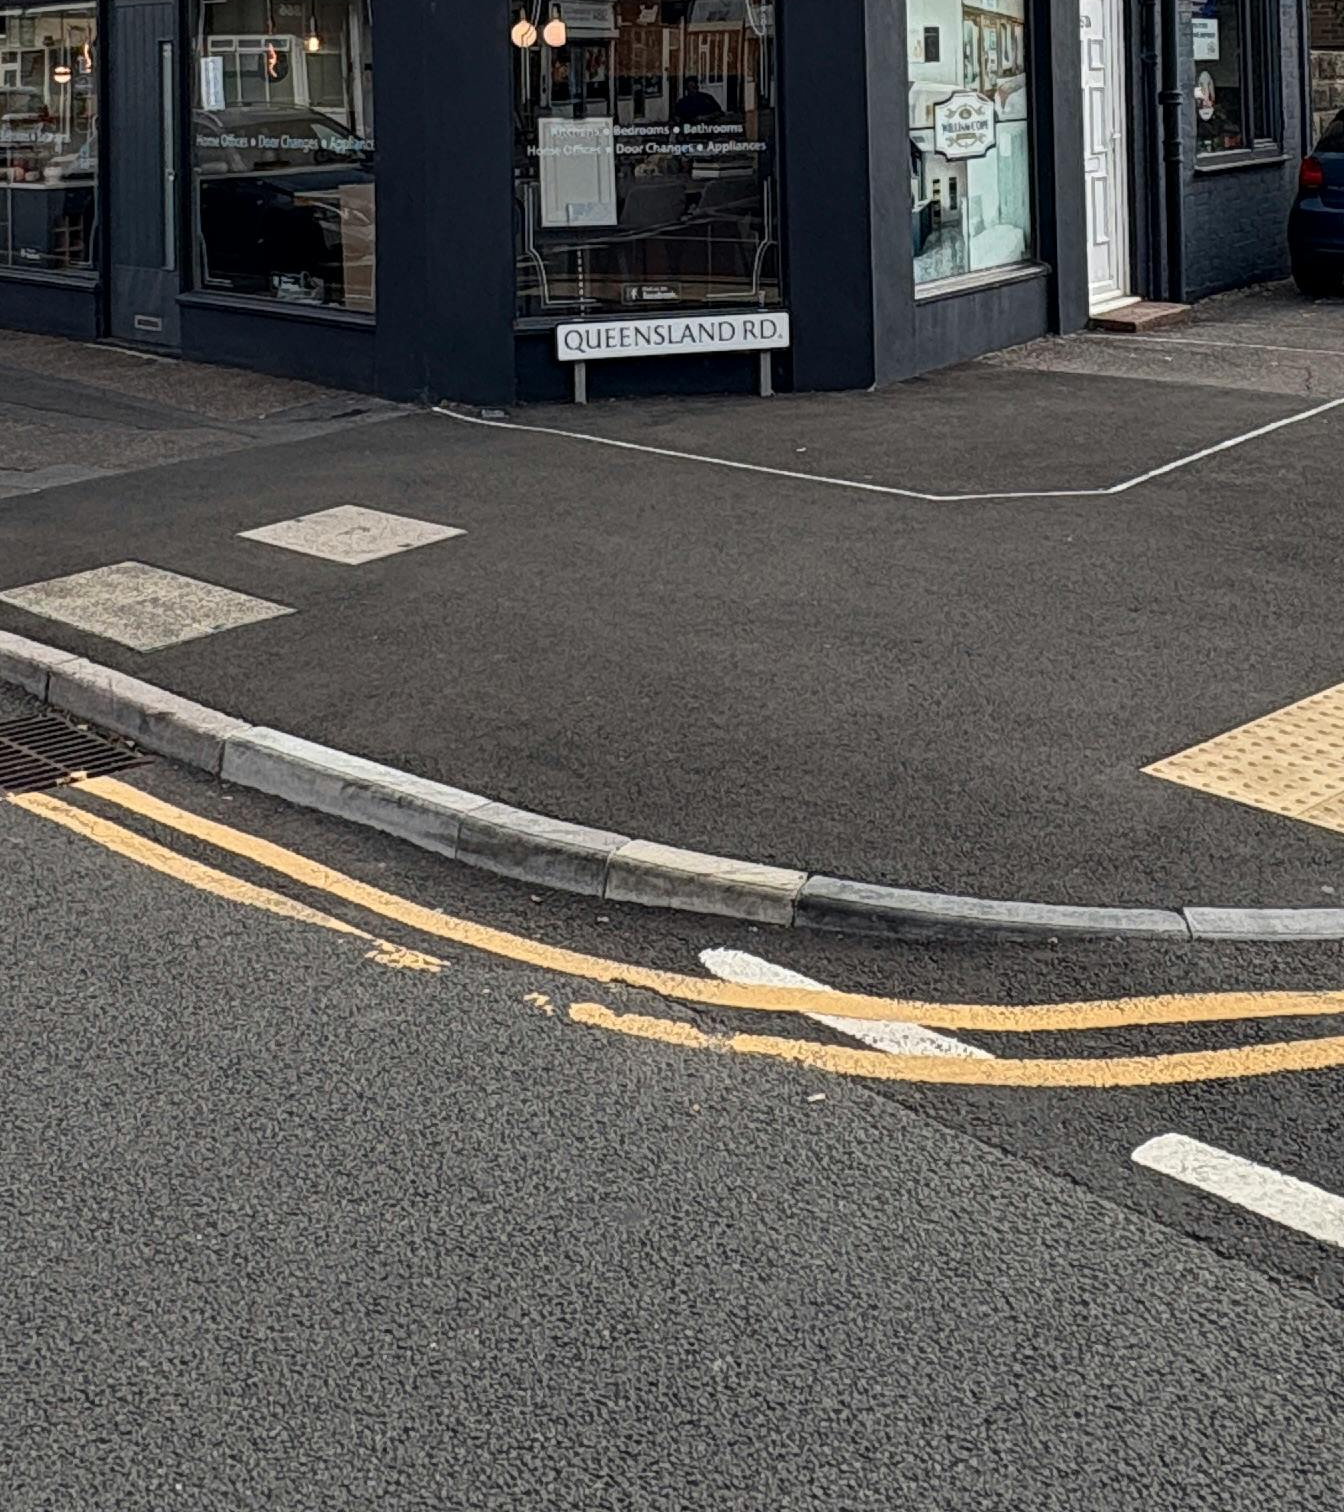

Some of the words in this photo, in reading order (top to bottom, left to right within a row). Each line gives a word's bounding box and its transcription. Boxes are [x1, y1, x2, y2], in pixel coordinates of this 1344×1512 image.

[613, 125, 670, 136] Bedrooms
[683, 123, 744, 134] Bathrooms
[616, 143, 643, 154] Door
[645, 142, 693, 155] Changes
[706, 141, 767, 153] Appliances
[564, 320, 736, 353] QUEENSLAND
